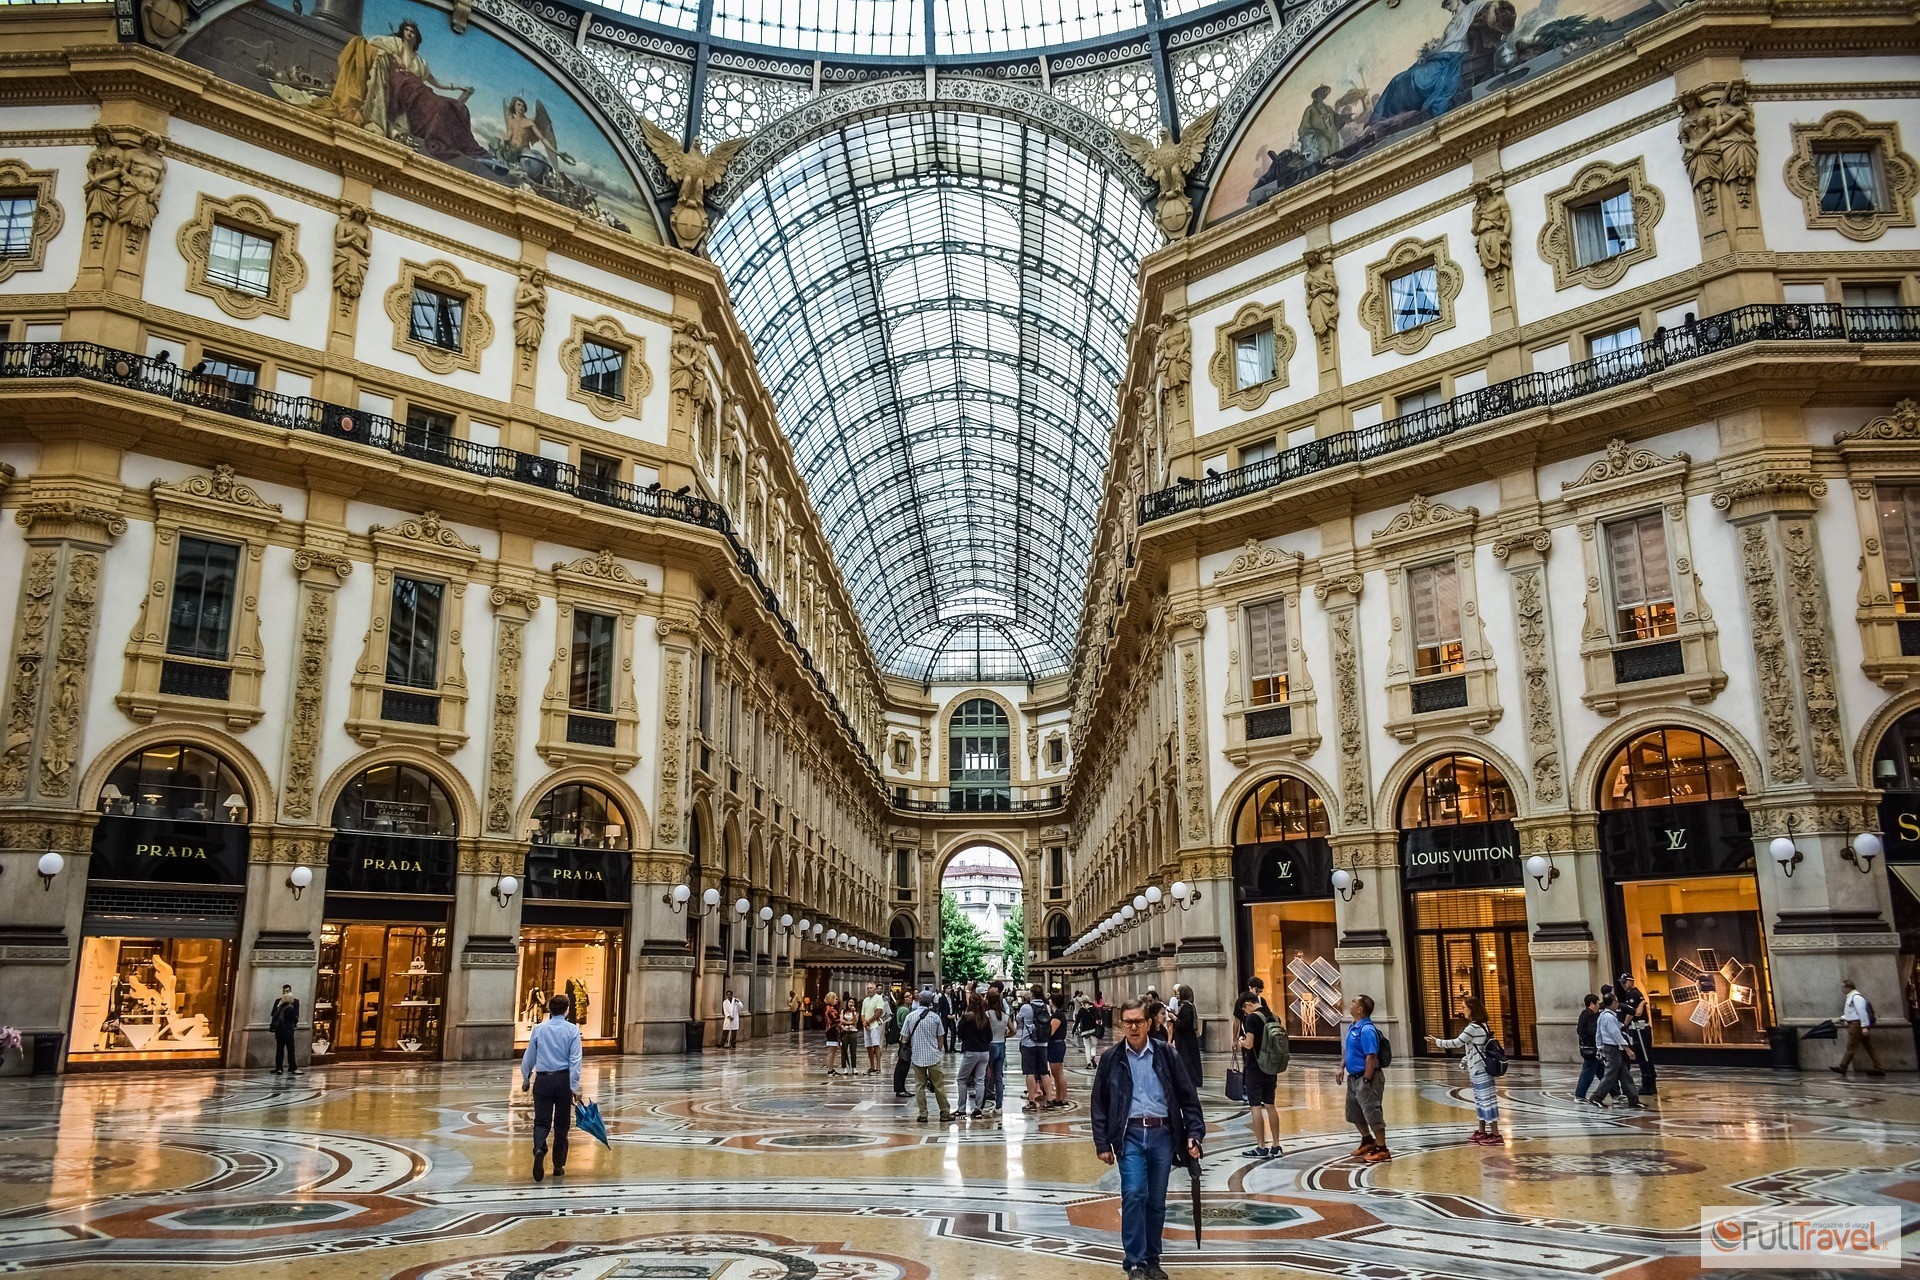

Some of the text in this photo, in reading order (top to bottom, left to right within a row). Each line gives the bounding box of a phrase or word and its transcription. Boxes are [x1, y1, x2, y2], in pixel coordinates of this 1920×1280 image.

[136, 844, 207, 859] PRADA
[1411, 845, 1514, 866] LOUIS VUITTON
[363, 858, 422, 872] PRADA
[553, 868, 603, 881] PRADA
